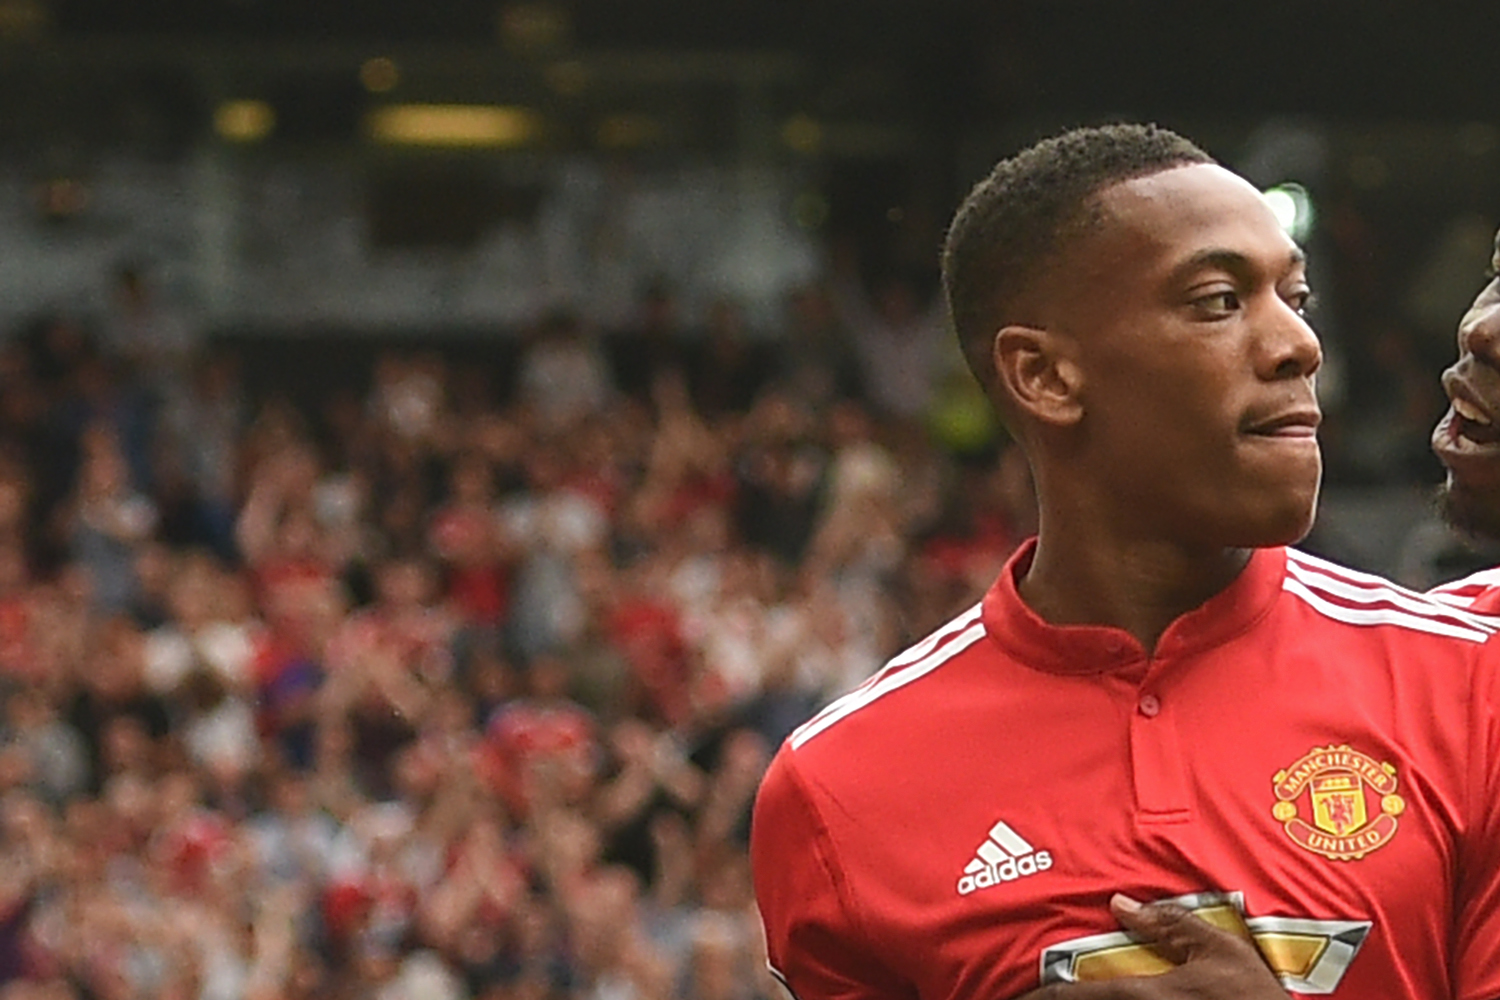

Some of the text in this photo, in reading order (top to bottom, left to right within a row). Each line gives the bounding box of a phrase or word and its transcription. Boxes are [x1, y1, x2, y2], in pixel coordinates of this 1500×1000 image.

[1284, 755, 1388, 794] MANCHESTER
[1308, 830, 1380, 852] UNITED
[957, 850, 1054, 895] adidas
